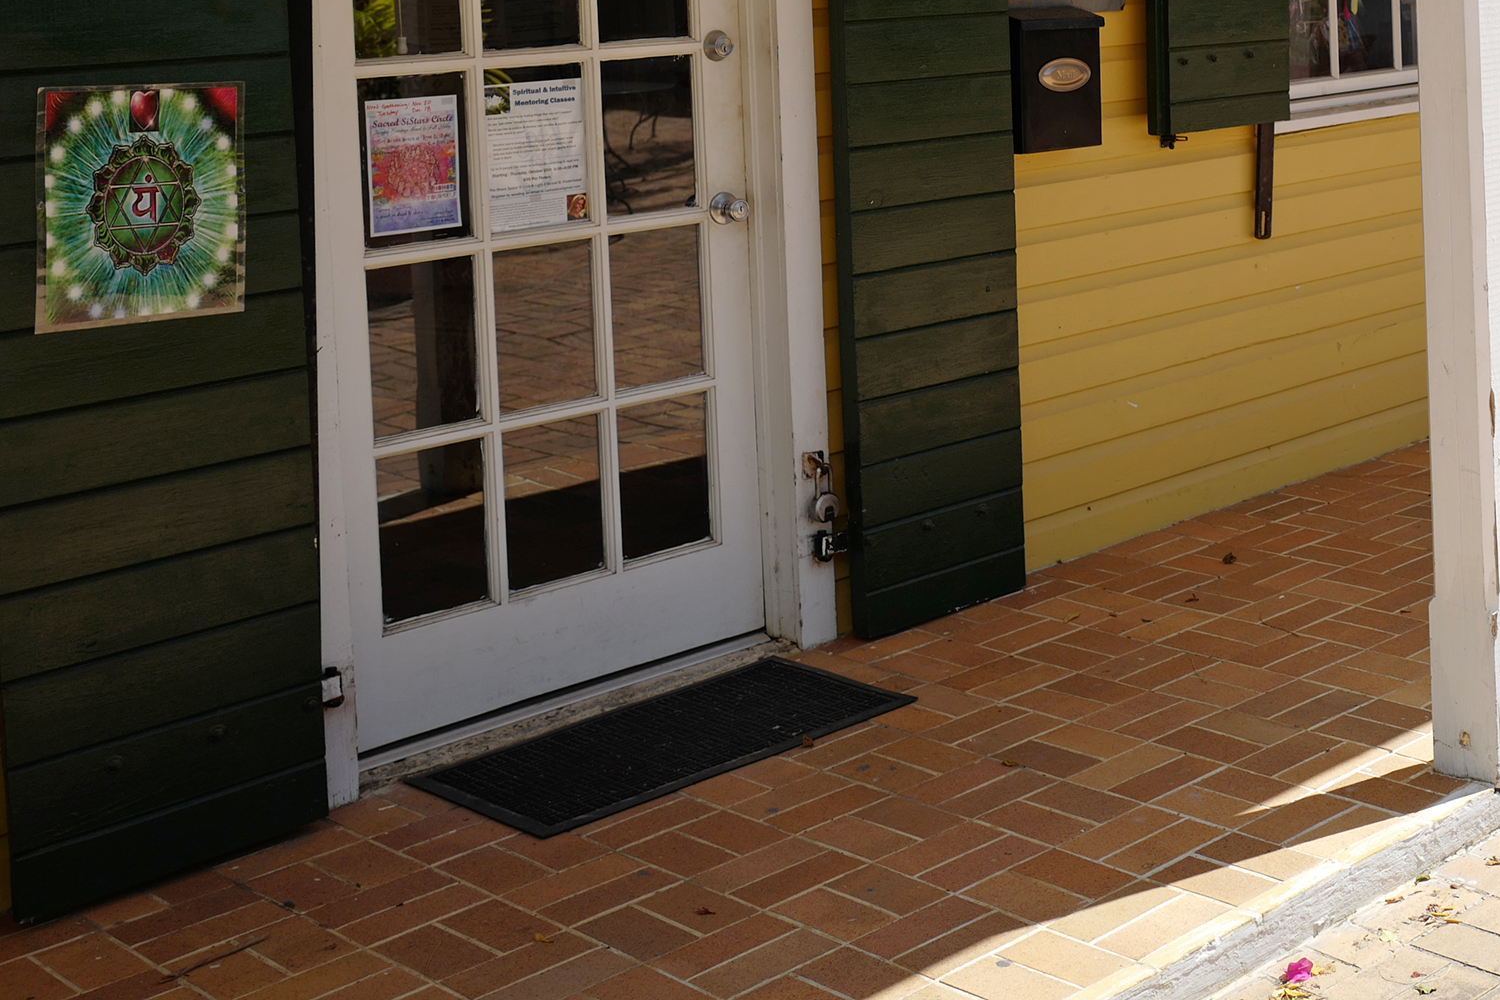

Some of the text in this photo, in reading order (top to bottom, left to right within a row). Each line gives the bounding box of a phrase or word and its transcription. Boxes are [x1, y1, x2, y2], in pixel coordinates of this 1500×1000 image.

[1057, 70, 1075, 79] Mail
[512, 88, 541, 96] Spiritual
[515, 98, 549, 106] Mentoring
[372, 114, 453, 128] Sacred SiStars Circle
